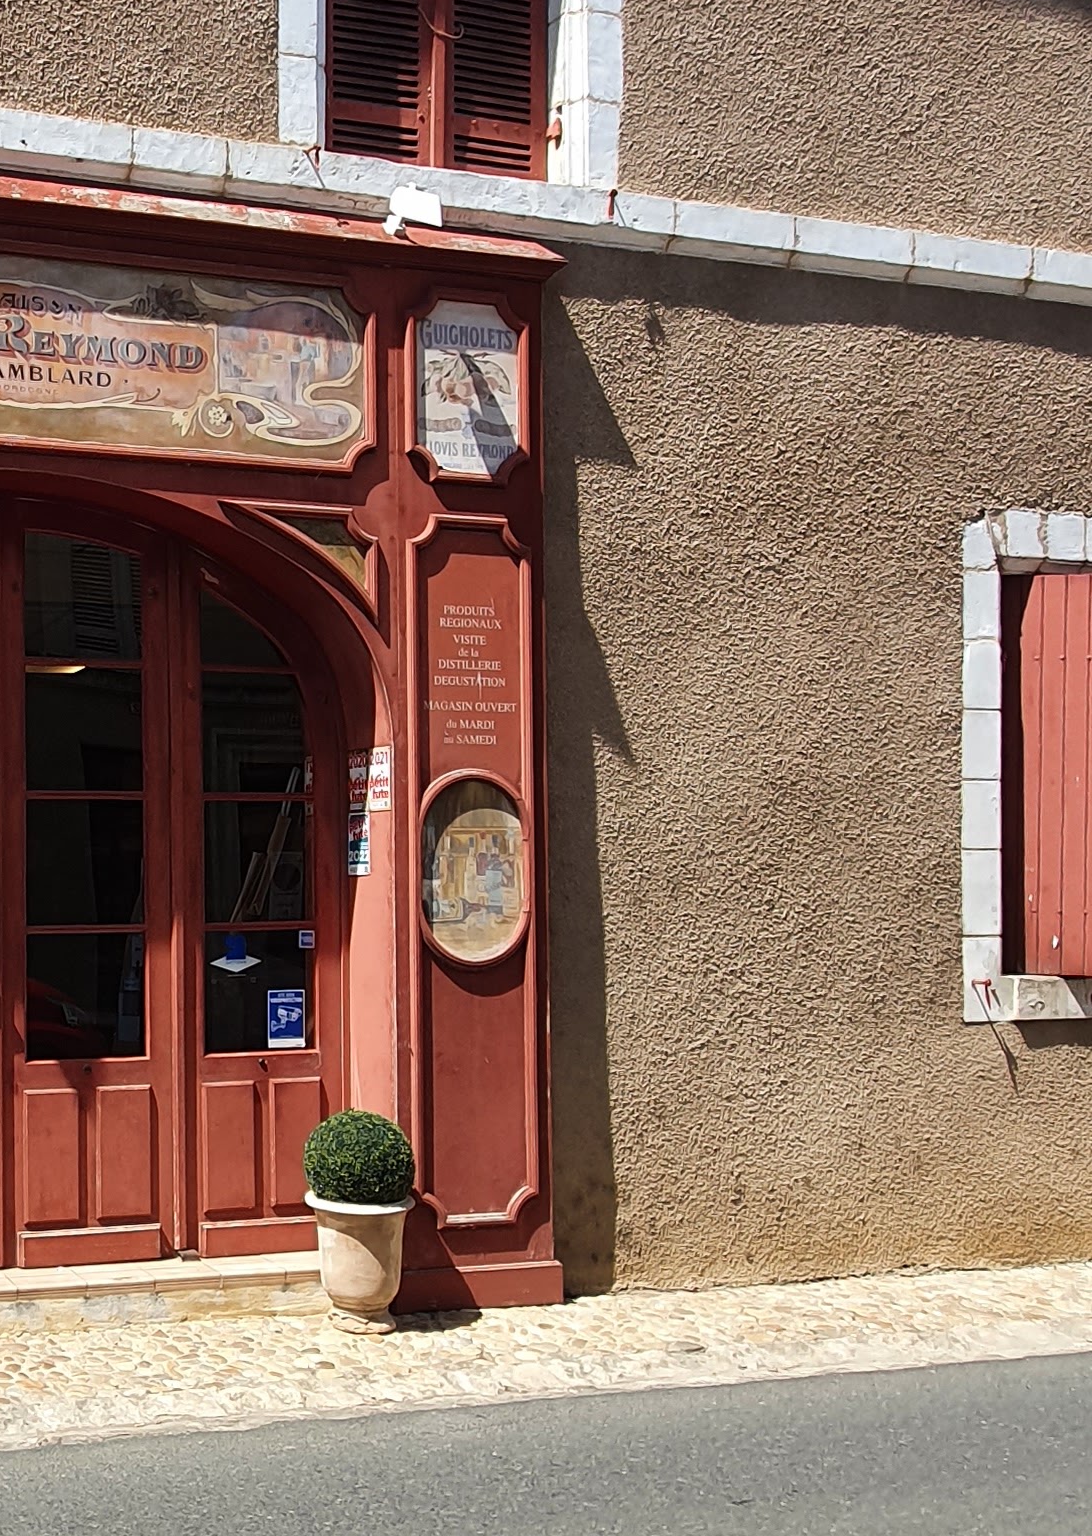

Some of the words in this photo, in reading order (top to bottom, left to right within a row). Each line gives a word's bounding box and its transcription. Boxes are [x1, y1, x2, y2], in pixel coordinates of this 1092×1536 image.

[419, 318, 513, 350] GUIGNOLETS
[427, 440, 459, 457] LOVIS
[443, 605, 495, 617] PRODUITS
[439, 617, 502, 630] REGIONAUX
[453, 634, 487, 646] VISITE
[458, 647, 469, 657] de
[471, 648, 479, 657] la
[438, 659, 501, 671] DISTILLERIE
[434, 675, 506, 687] DEGUSTATION
[424, 700, 473, 712] MAGASIN
[475, 701, 517, 713] OUVERT
[446, 719, 457, 729] du
[459, 719, 495, 730] MARDI
[456, 734, 497, 745] SAMEDI
[348, 850, 369, 862] 2022
